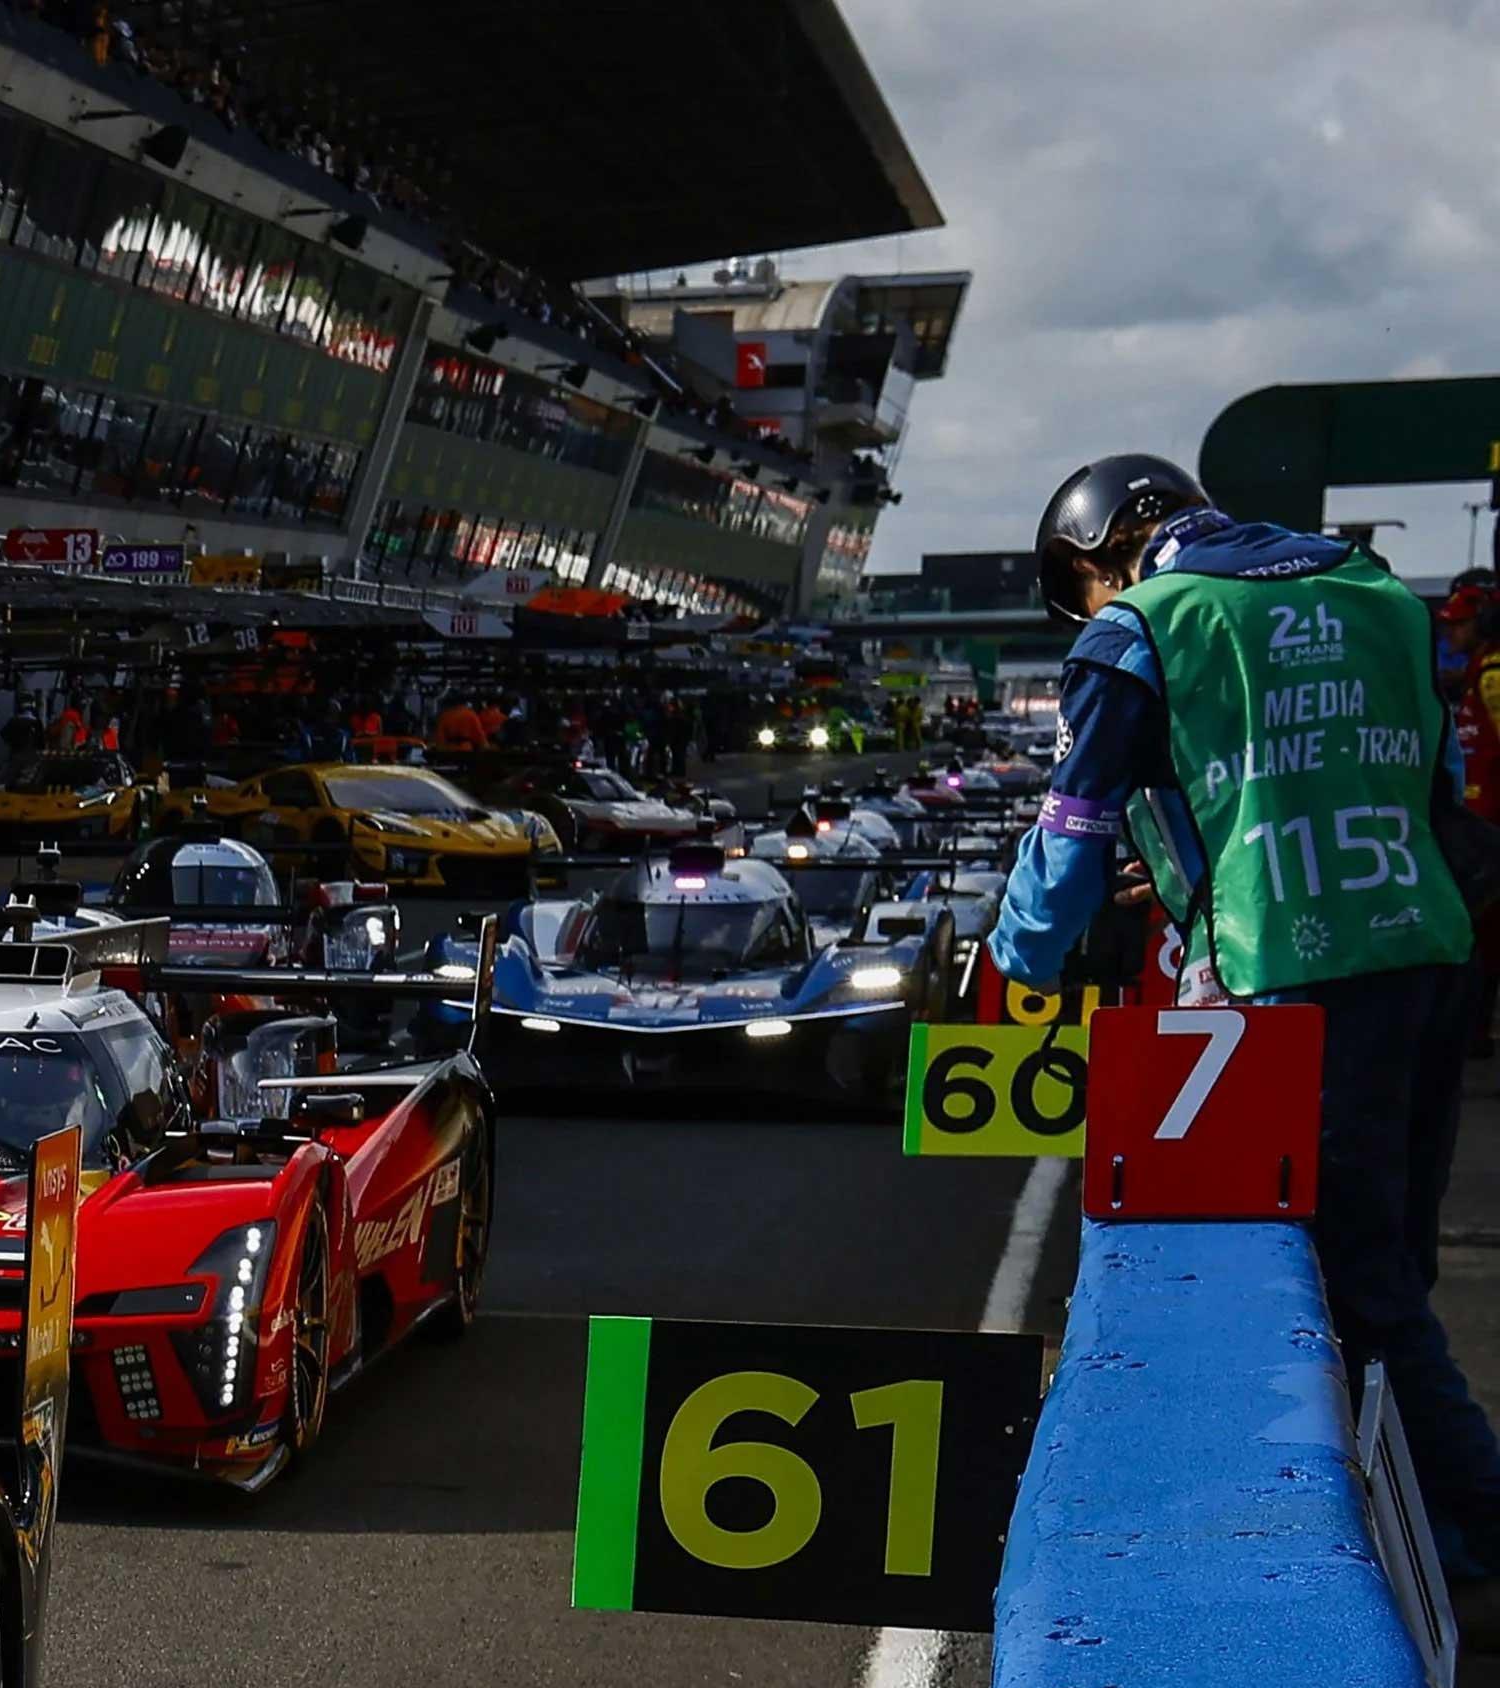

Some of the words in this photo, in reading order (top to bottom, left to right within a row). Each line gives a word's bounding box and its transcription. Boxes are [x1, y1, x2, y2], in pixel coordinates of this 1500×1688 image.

[64, 531, 92, 561] 13
[131, 549, 160, 570] 199
[1263, 679, 1366, 729] MEDIA
[1206, 730, 1327, 800] PILANE
[921, 1045, 1088, 1137] 60
[1153, 1009, 1248, 1141] 7
[658, 1369, 945, 1578] 61
